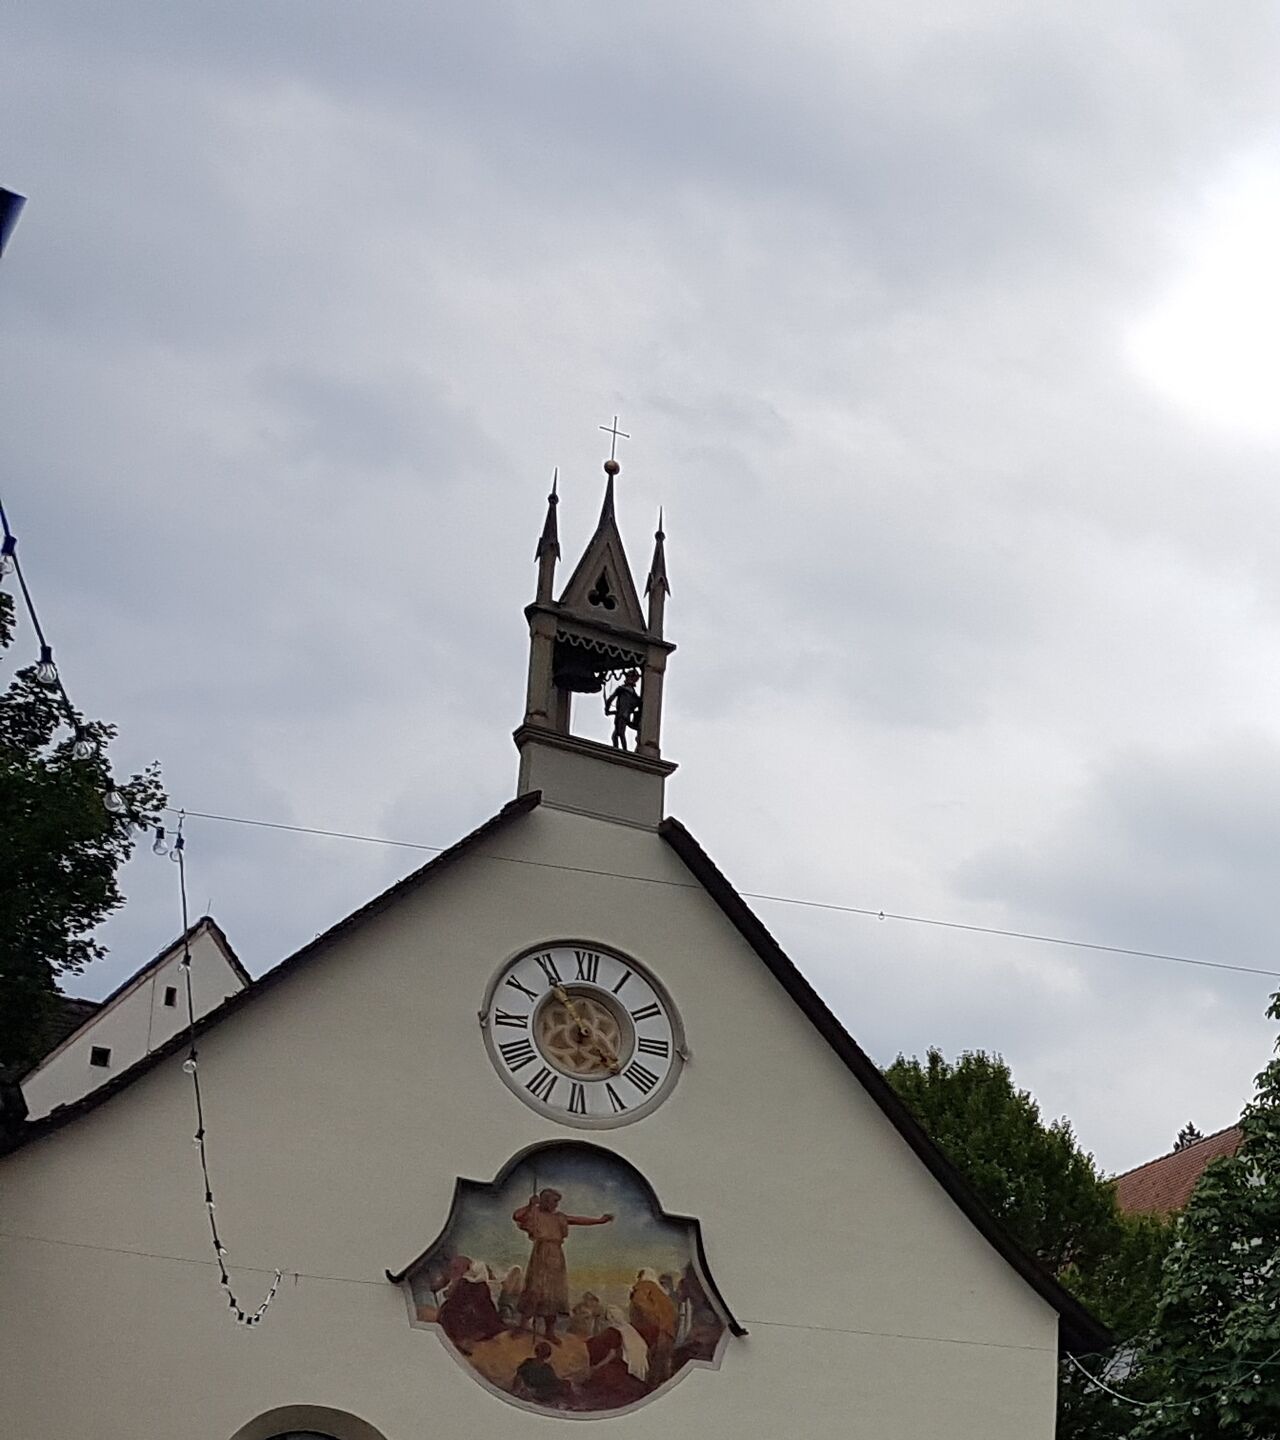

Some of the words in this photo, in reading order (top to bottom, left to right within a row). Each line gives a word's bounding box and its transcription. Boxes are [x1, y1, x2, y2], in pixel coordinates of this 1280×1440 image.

[574, 951, 600, 983] XII
[505, 975, 538, 1002] X
[612, 970, 632, 994] I
[495, 1008, 528, 1028] IX
[631, 1002, 661, 1023] II
[498, 1038, 537, 1073] VIII
[638, 1036, 669, 1058] III
[525, 1066, 558, 1102] VII
[623, 1060, 660, 1095] IIII
[568, 1083, 587, 1114] VI
[605, 1083, 627, 1112] V
